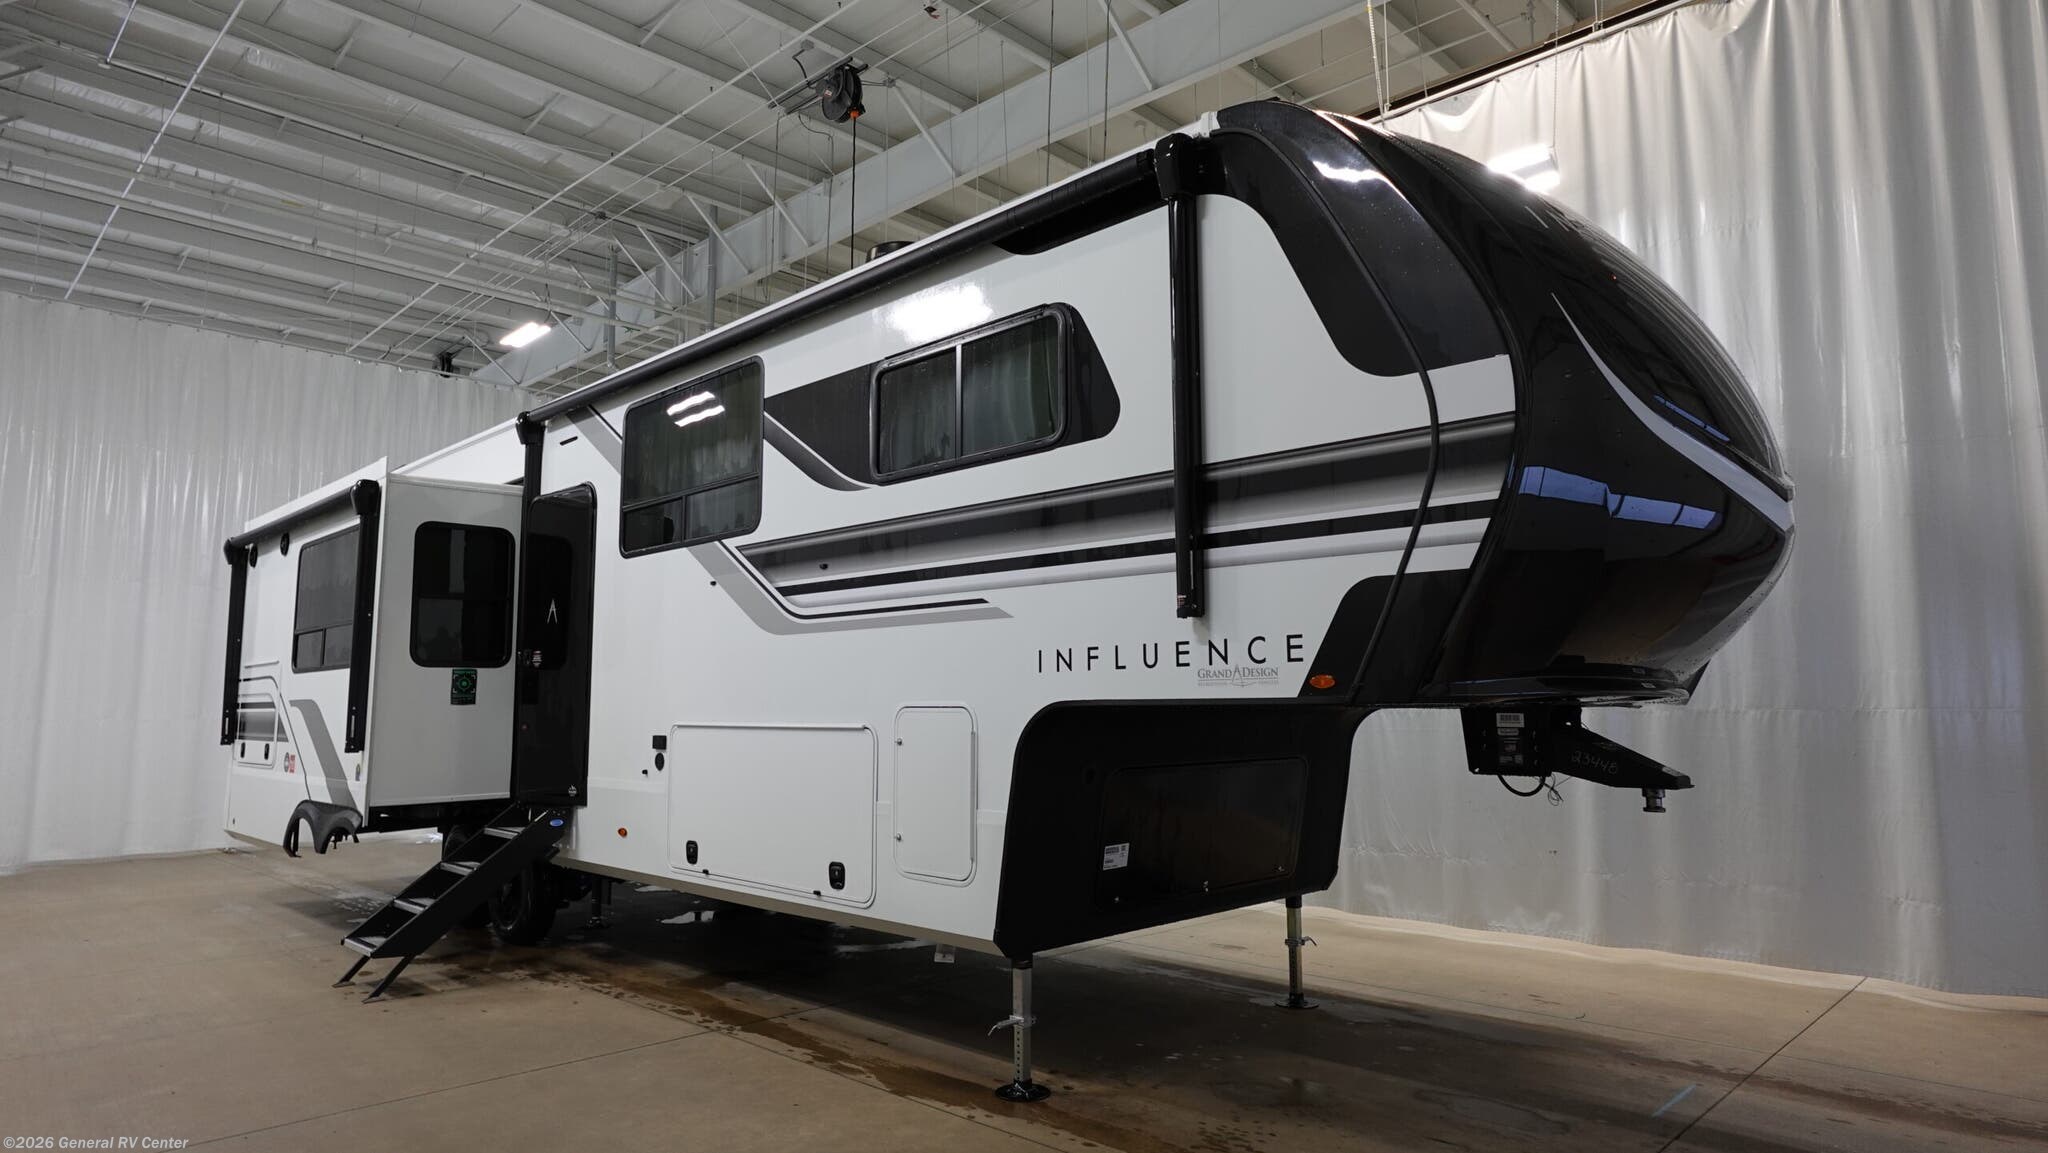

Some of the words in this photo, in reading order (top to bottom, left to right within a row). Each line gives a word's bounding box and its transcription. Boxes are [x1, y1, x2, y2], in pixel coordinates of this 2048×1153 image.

[1038, 634, 1304, 673] INFLUENCE
[1197, 668, 1233, 679] GRAND
[1242, 667, 1279, 677] DESIGN
